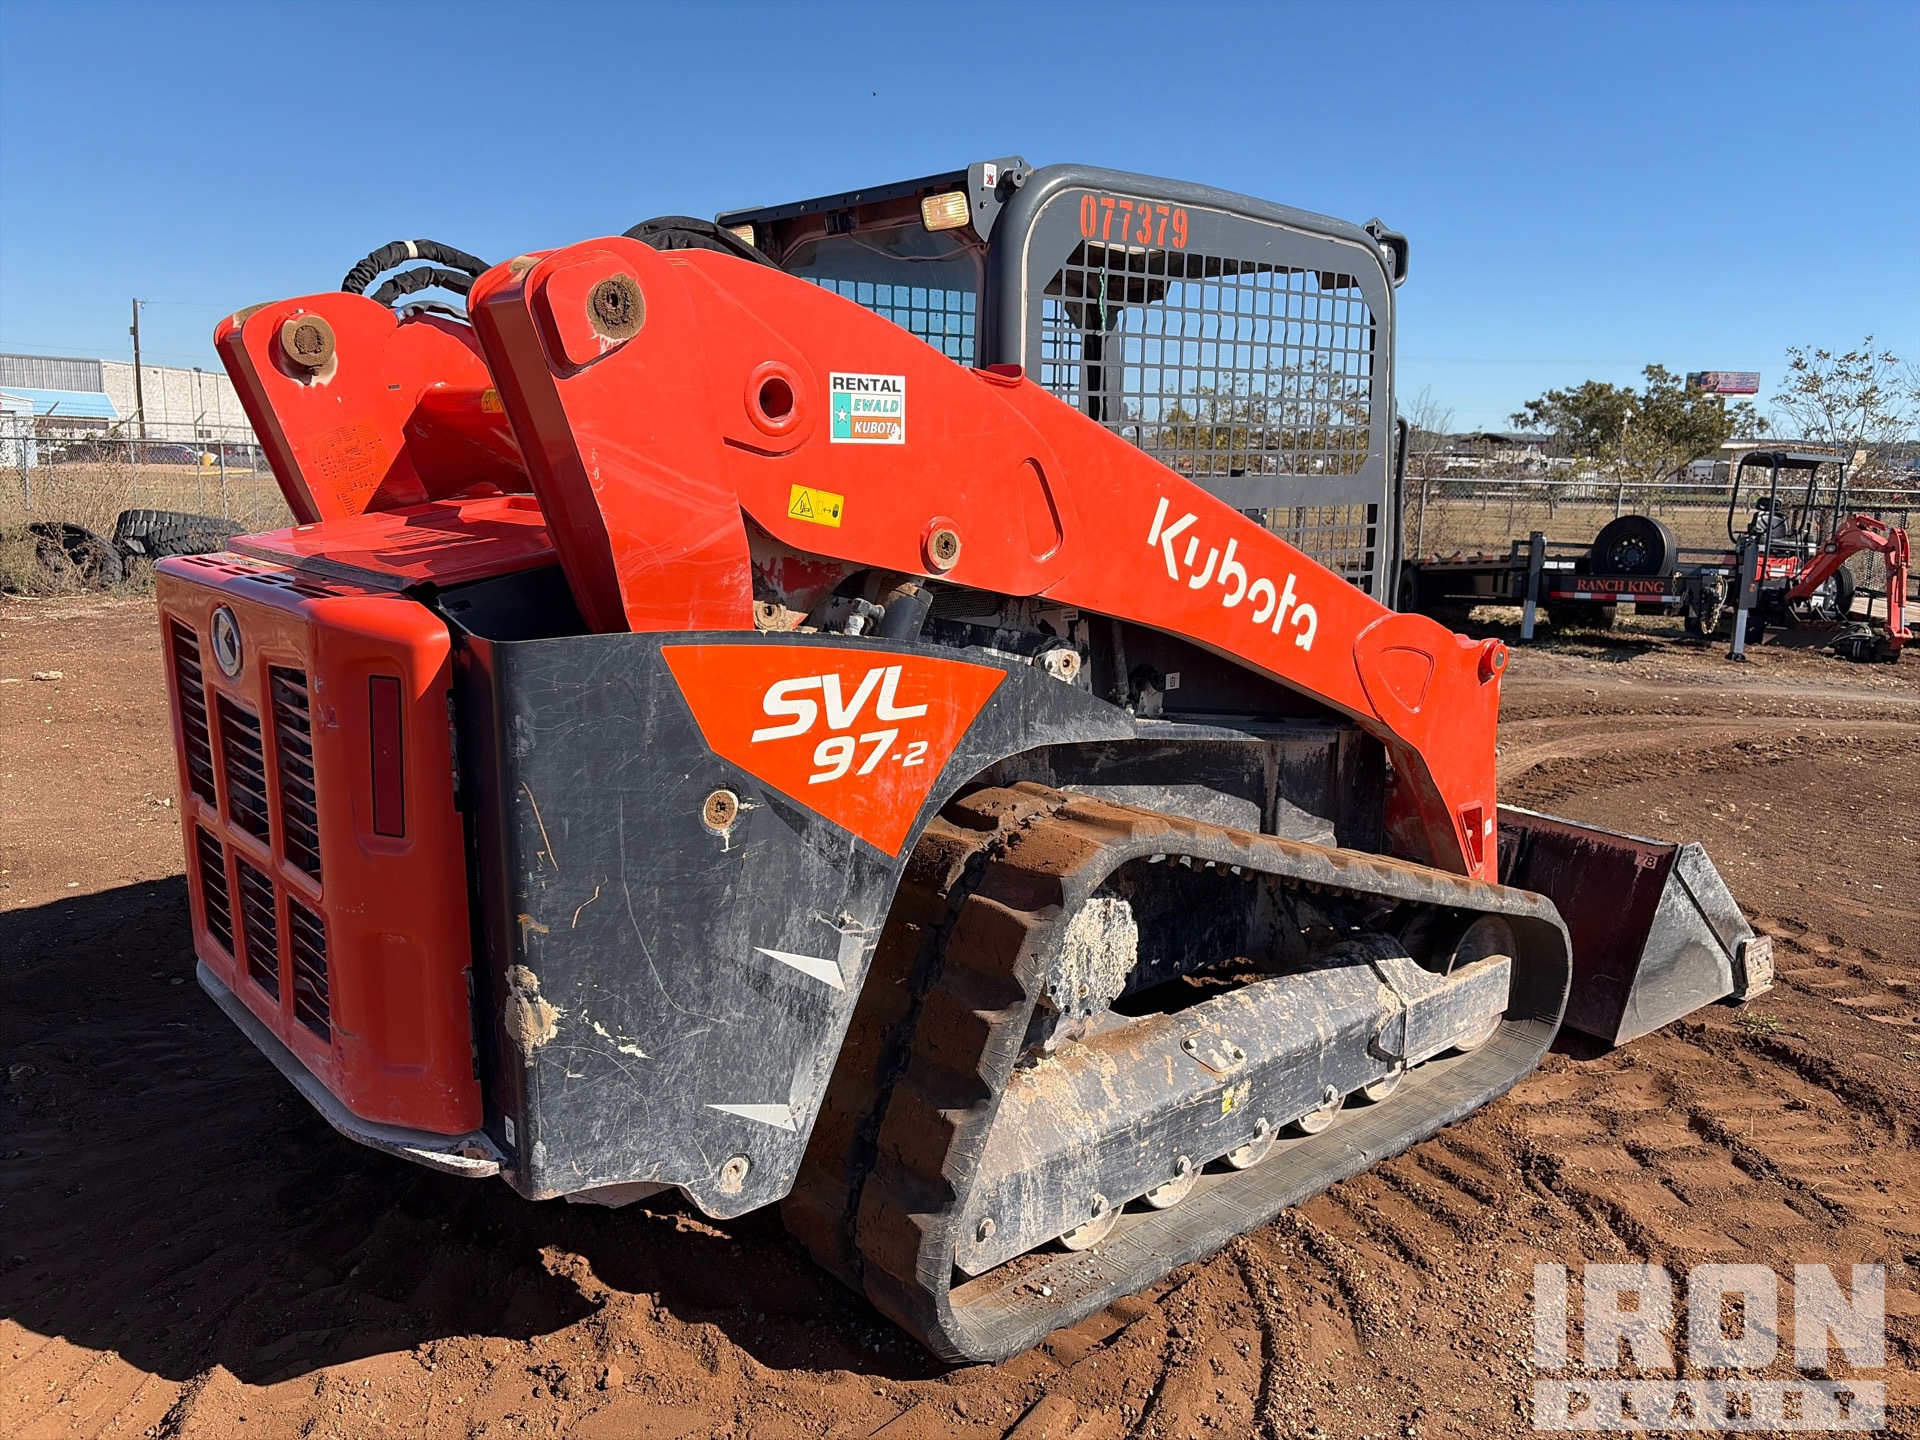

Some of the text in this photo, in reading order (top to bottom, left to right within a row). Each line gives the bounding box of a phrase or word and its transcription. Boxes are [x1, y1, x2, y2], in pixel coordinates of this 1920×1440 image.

[1080, 194, 1188, 249] 077379
[832, 376, 902, 393] RENTAL
[853, 399, 900, 413] EWALD
[854, 421, 900, 435] KUBOTA
[1147, 496, 1318, 652] Kubota
[1576, 579, 1666, 594] RANCH KING
[751, 665, 928, 743] SVL
[808, 728, 929, 785] 97-2
